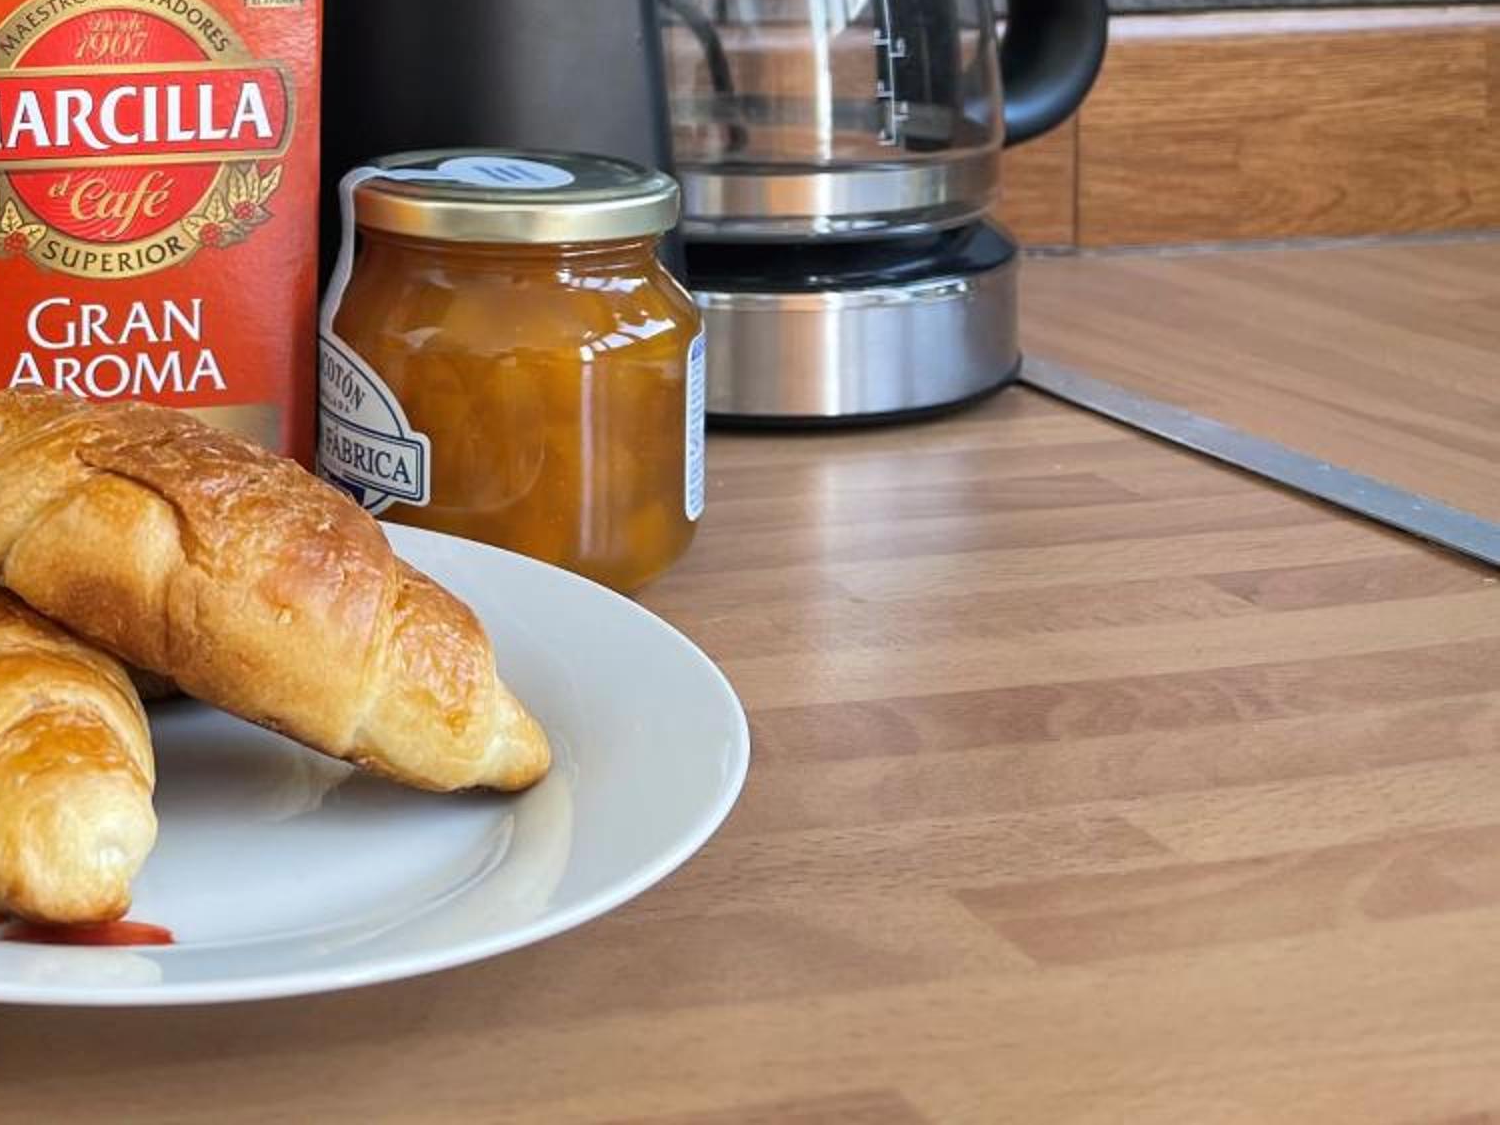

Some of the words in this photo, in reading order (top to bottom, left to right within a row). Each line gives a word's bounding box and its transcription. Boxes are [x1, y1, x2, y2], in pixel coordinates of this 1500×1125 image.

[75, 30, 149, 59] 1907
[48, 174, 71, 198] el
[70, 170, 174, 238] Café
[41, 235, 186, 273] SUPERIOR
[26, 297, 204, 350] GRAN
[8, 347, 228, 399] AROMA
[325, 424, 413, 485] FÁBRICA
